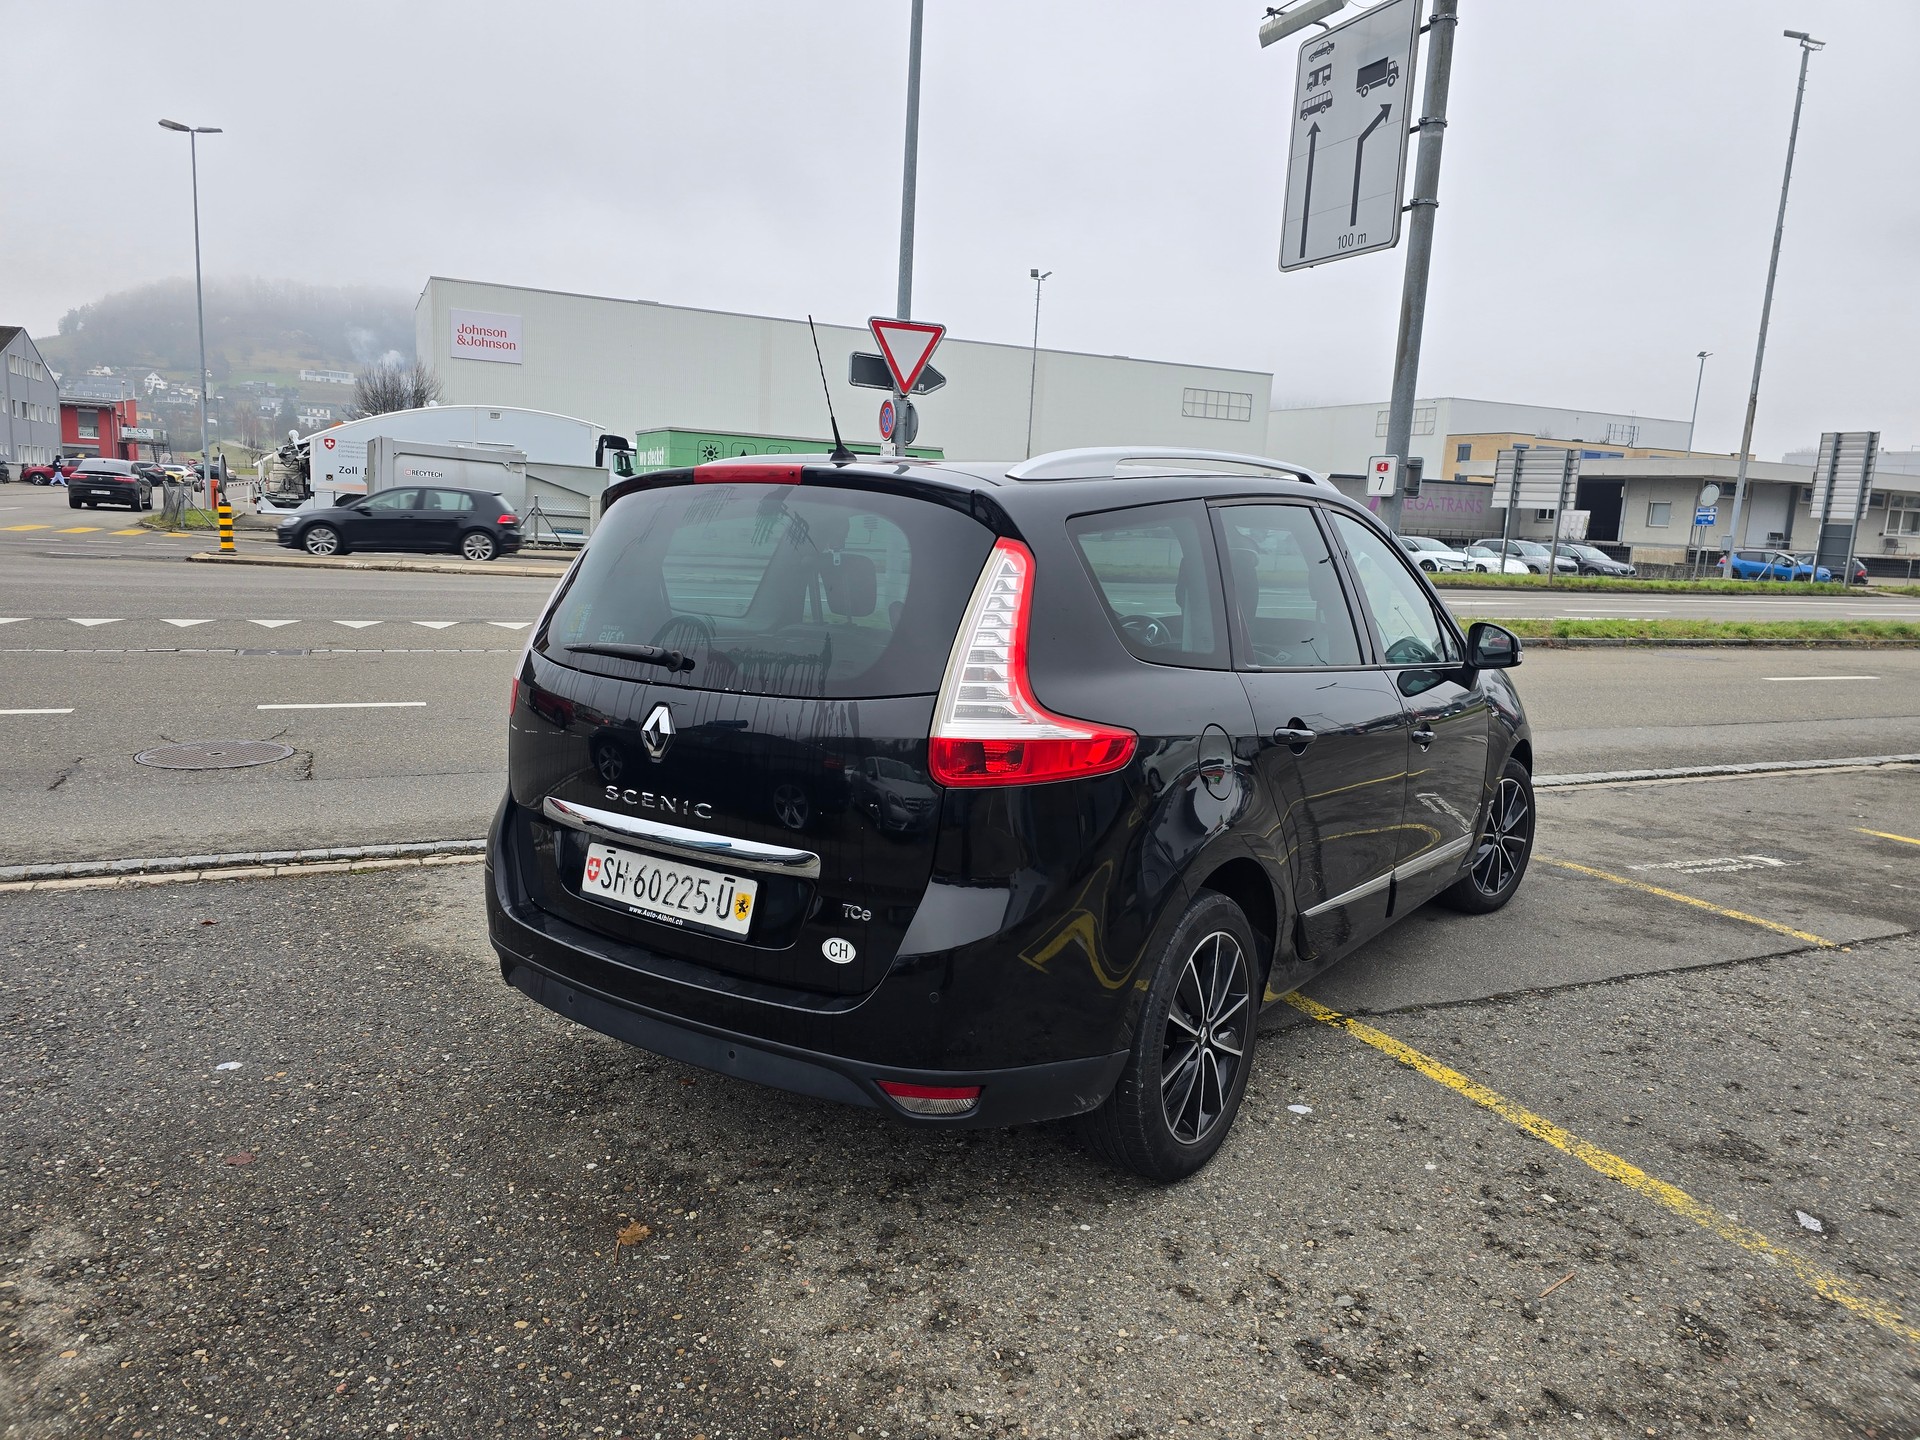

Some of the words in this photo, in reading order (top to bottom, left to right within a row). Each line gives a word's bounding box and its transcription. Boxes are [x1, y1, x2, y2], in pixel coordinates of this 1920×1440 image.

[1338, 233, 1354, 249] 100
[1357, 232, 1367, 245] m
[457, 323, 507, 338] Johnson
[457, 334, 517, 350] &Johnson
[339, 466, 358, 475] Zoll
[411, 469, 443, 478] RECYTECH
[1380, 463, 1385, 471] 4
[1378, 476, 1385, 490] 7
[605, 785, 712, 819] SCENIC
[628, 906, 684, 926] www.Auto-Albini.ch
[842, 903, 872, 921] TCe
[829, 941, 848, 959] CH
